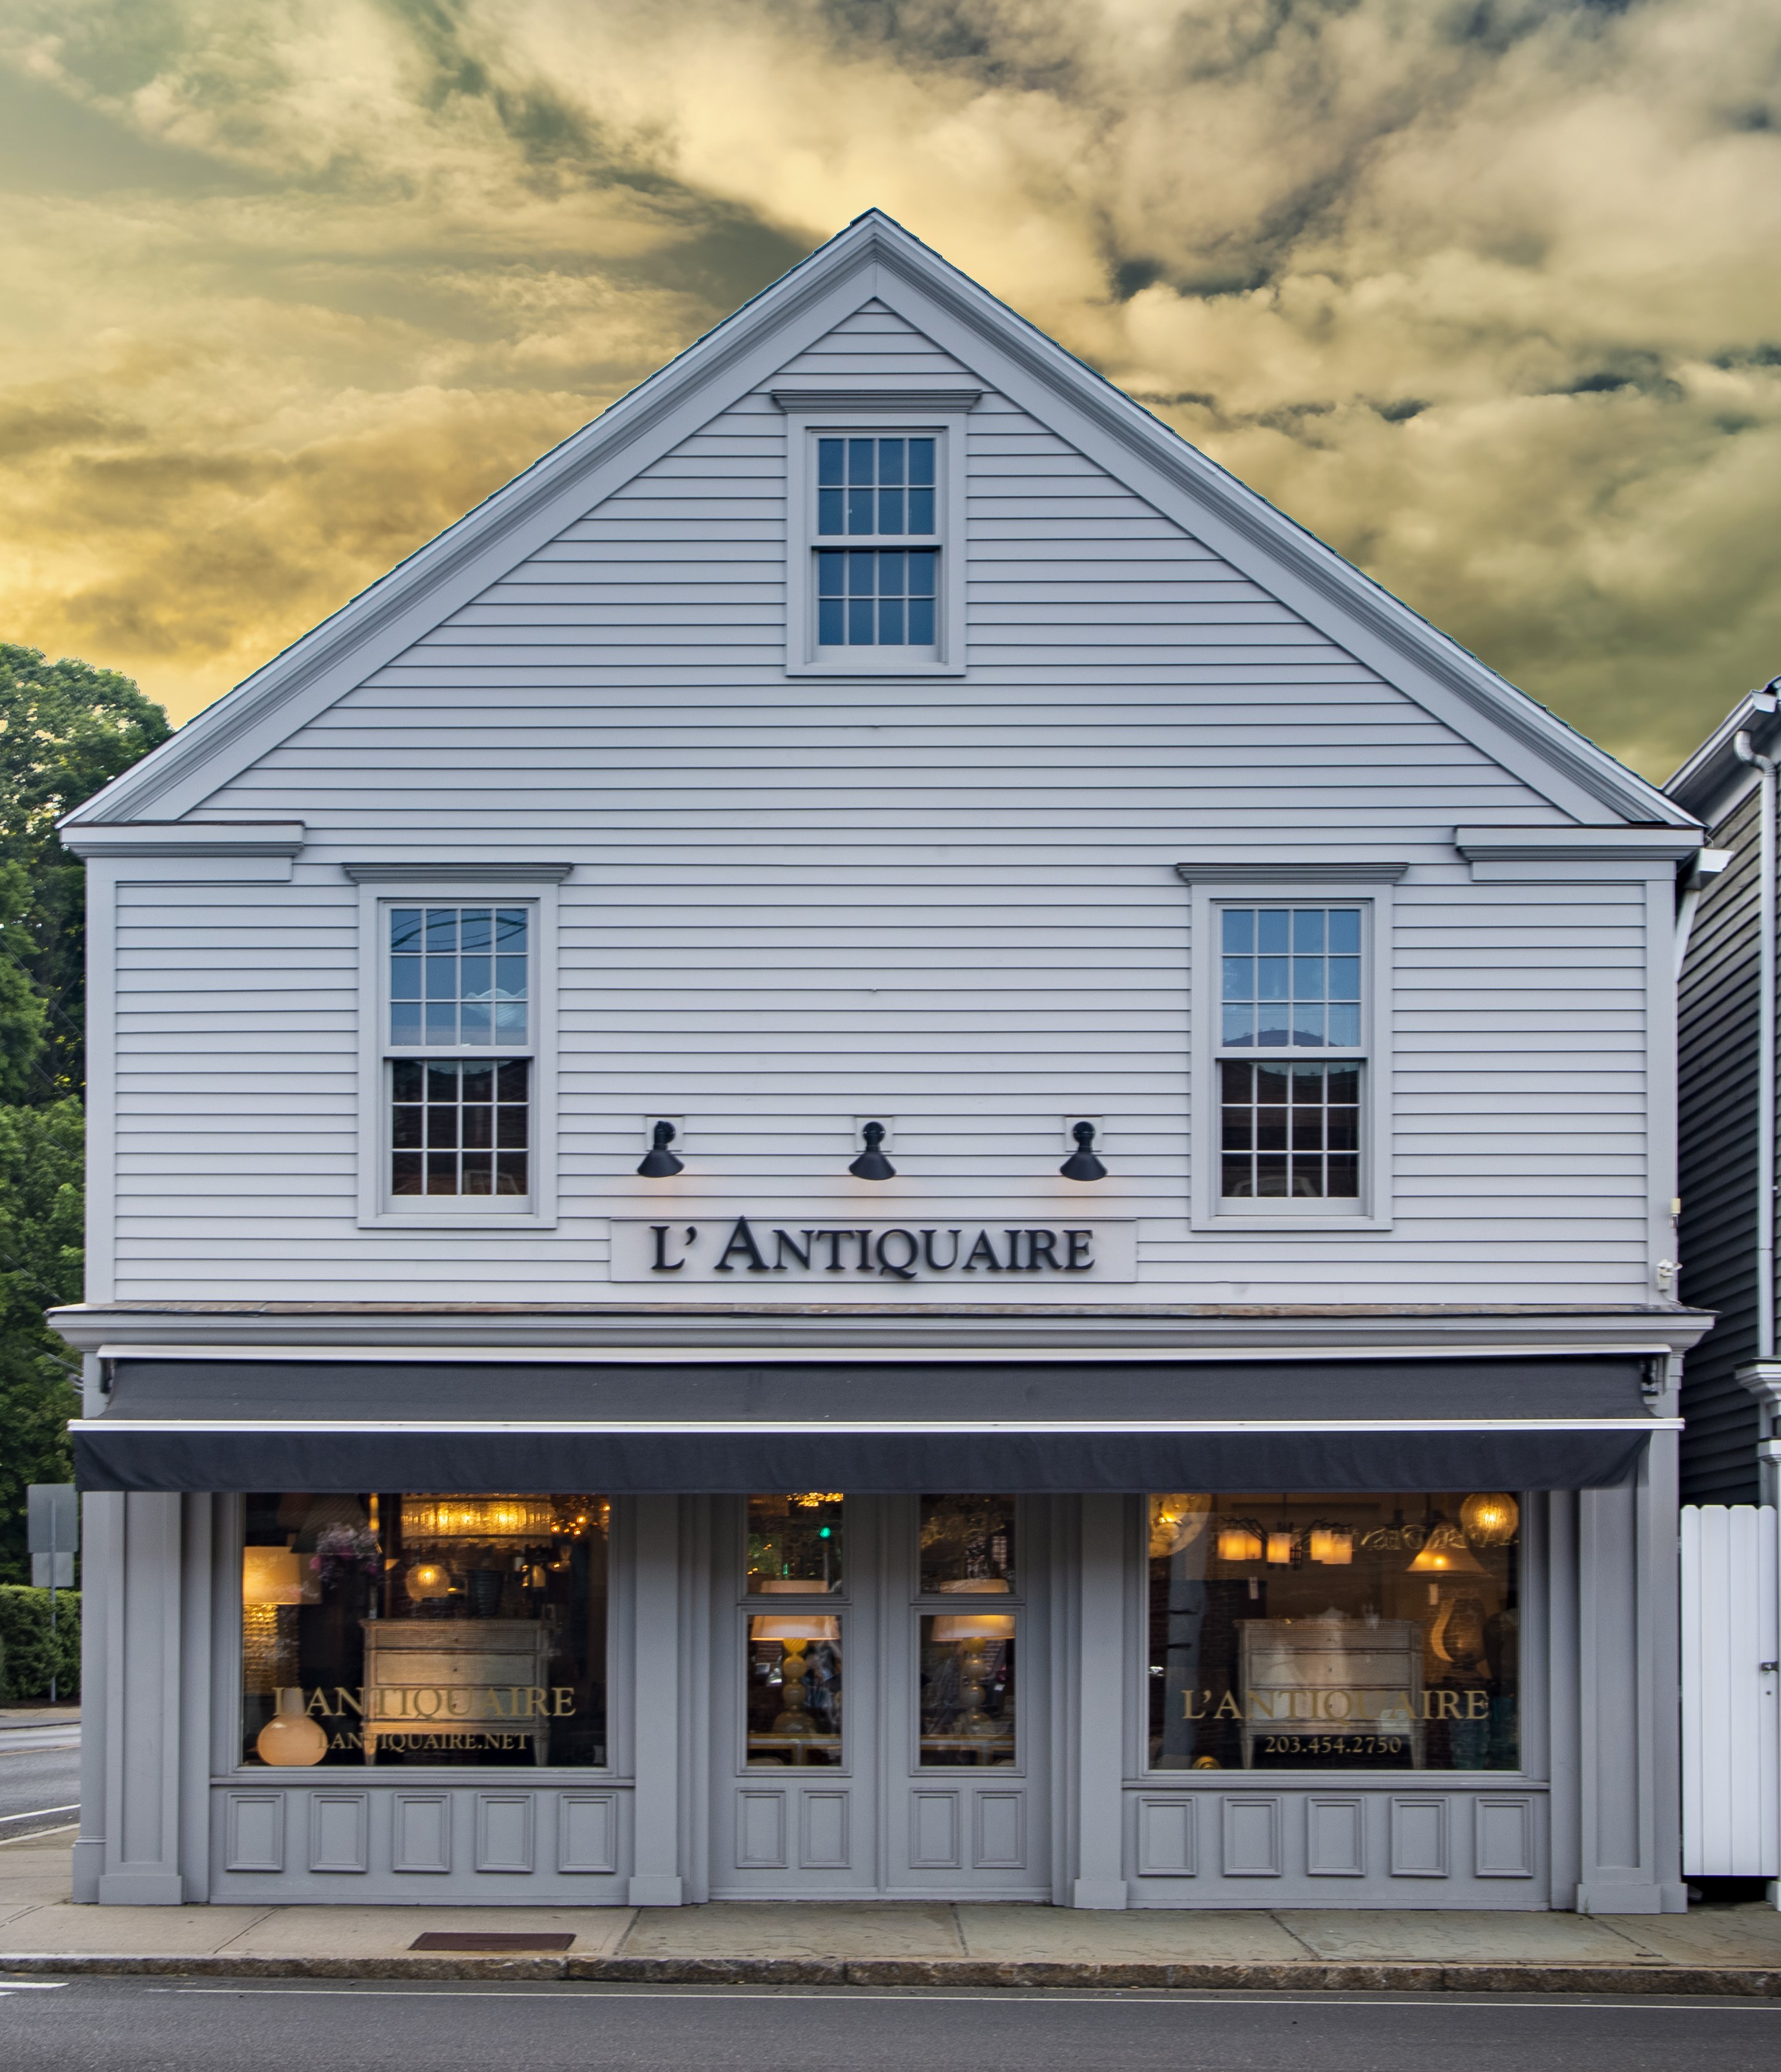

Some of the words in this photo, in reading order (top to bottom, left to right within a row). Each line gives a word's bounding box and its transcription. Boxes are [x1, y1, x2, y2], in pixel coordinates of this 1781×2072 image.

[650, 1216, 1095, 1279] L'ANTIQUAIRE
[1181, 1689, 1490, 1726] L'ANTIQUAIRE
[1264, 1736, 1402, 1754] 203.454.2750
